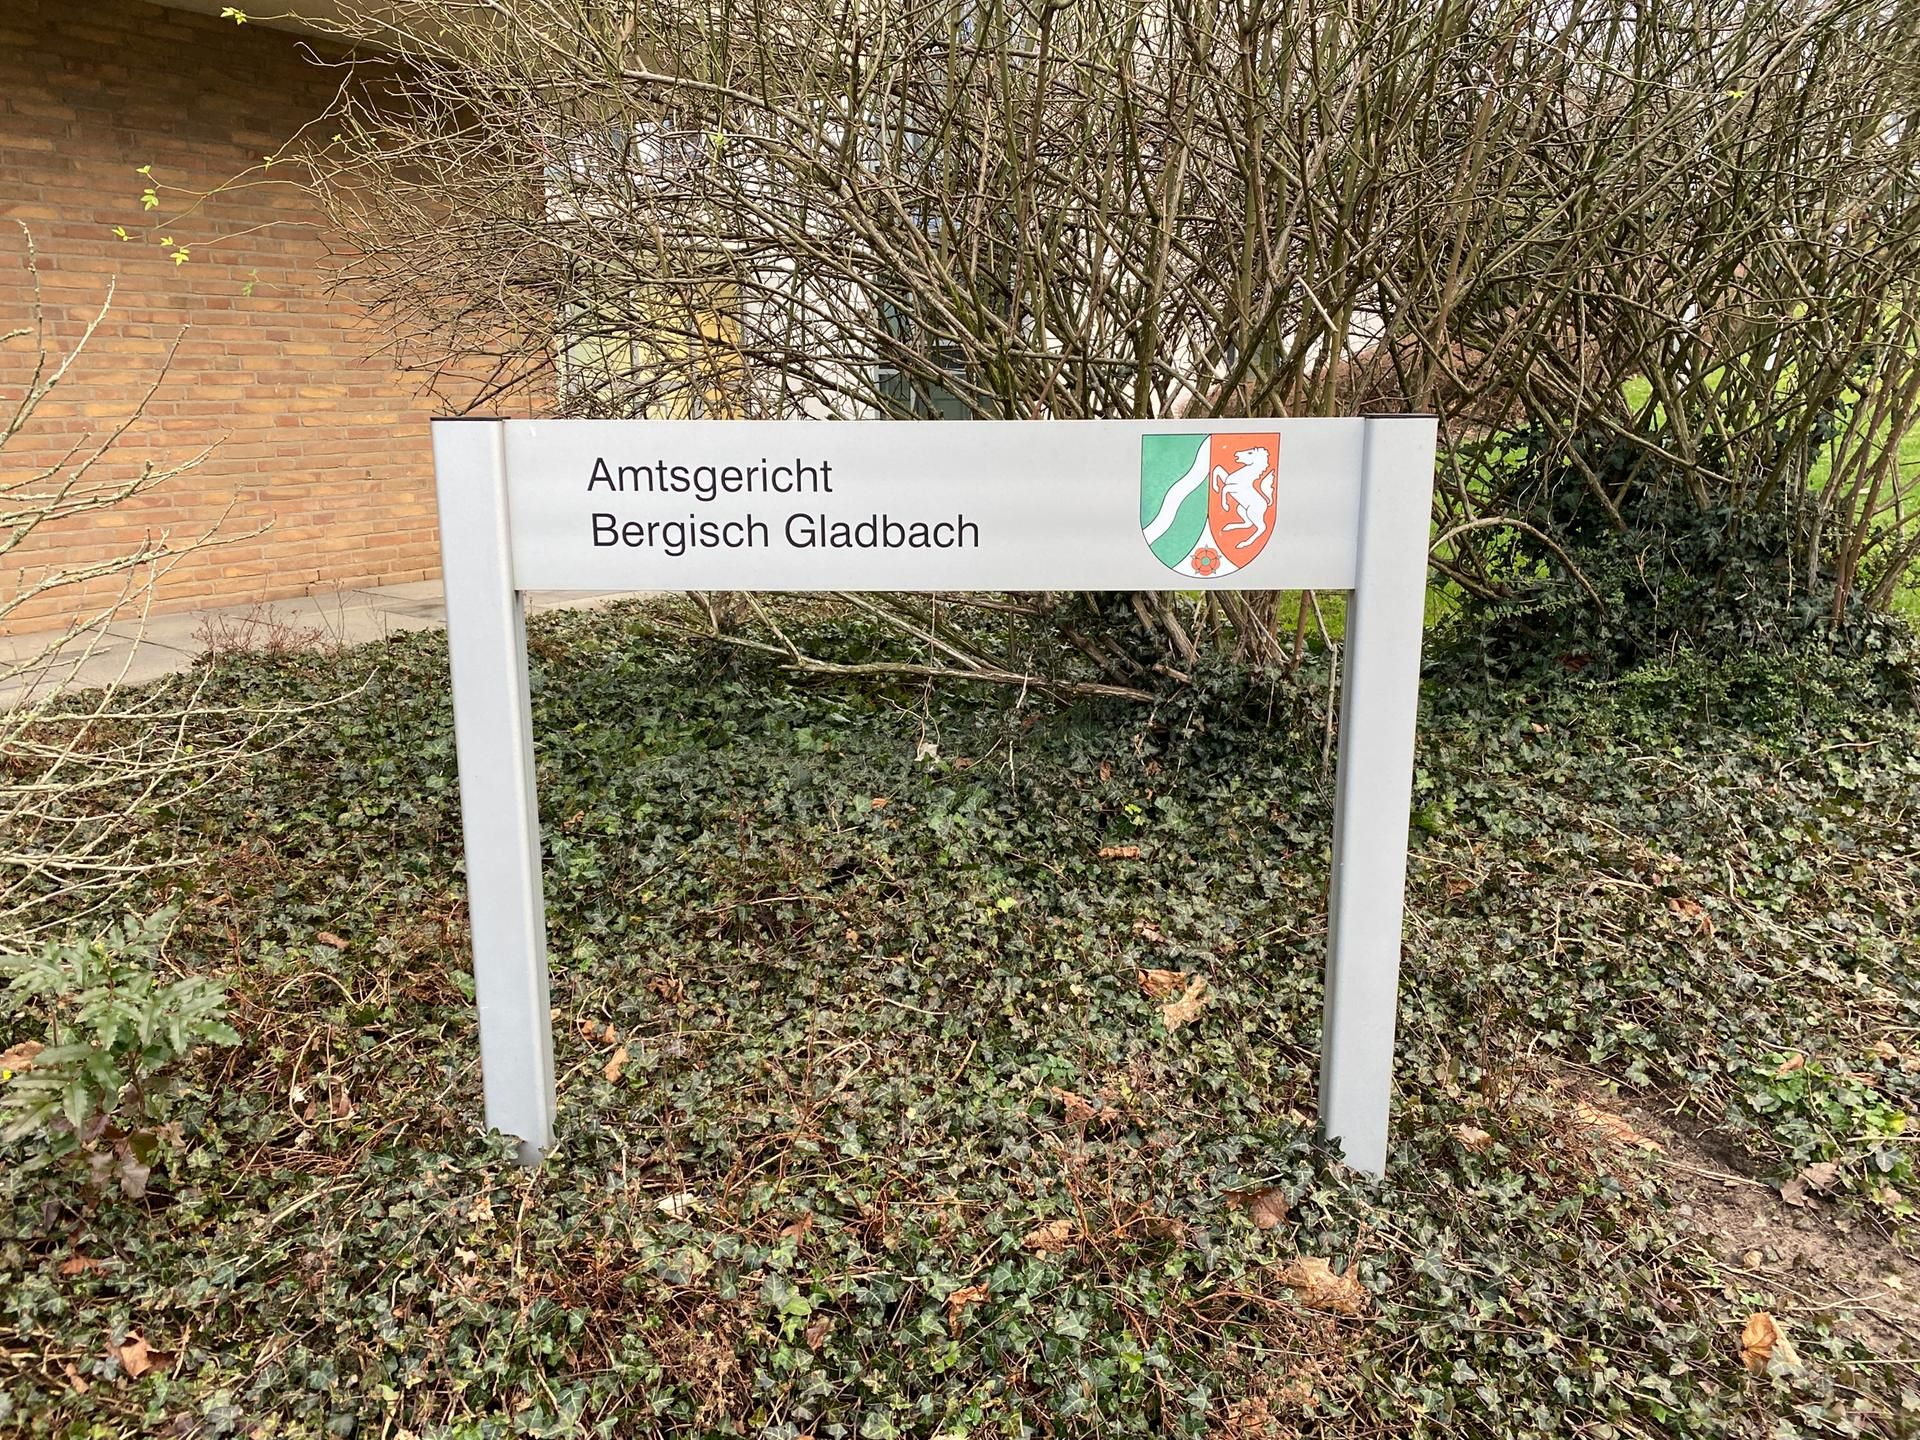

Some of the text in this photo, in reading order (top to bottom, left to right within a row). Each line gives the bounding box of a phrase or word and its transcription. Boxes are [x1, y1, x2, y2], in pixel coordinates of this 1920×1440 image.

[587, 457, 833, 502] Amtsgericht
[591, 513, 979, 557] Bergisch Gladbach
